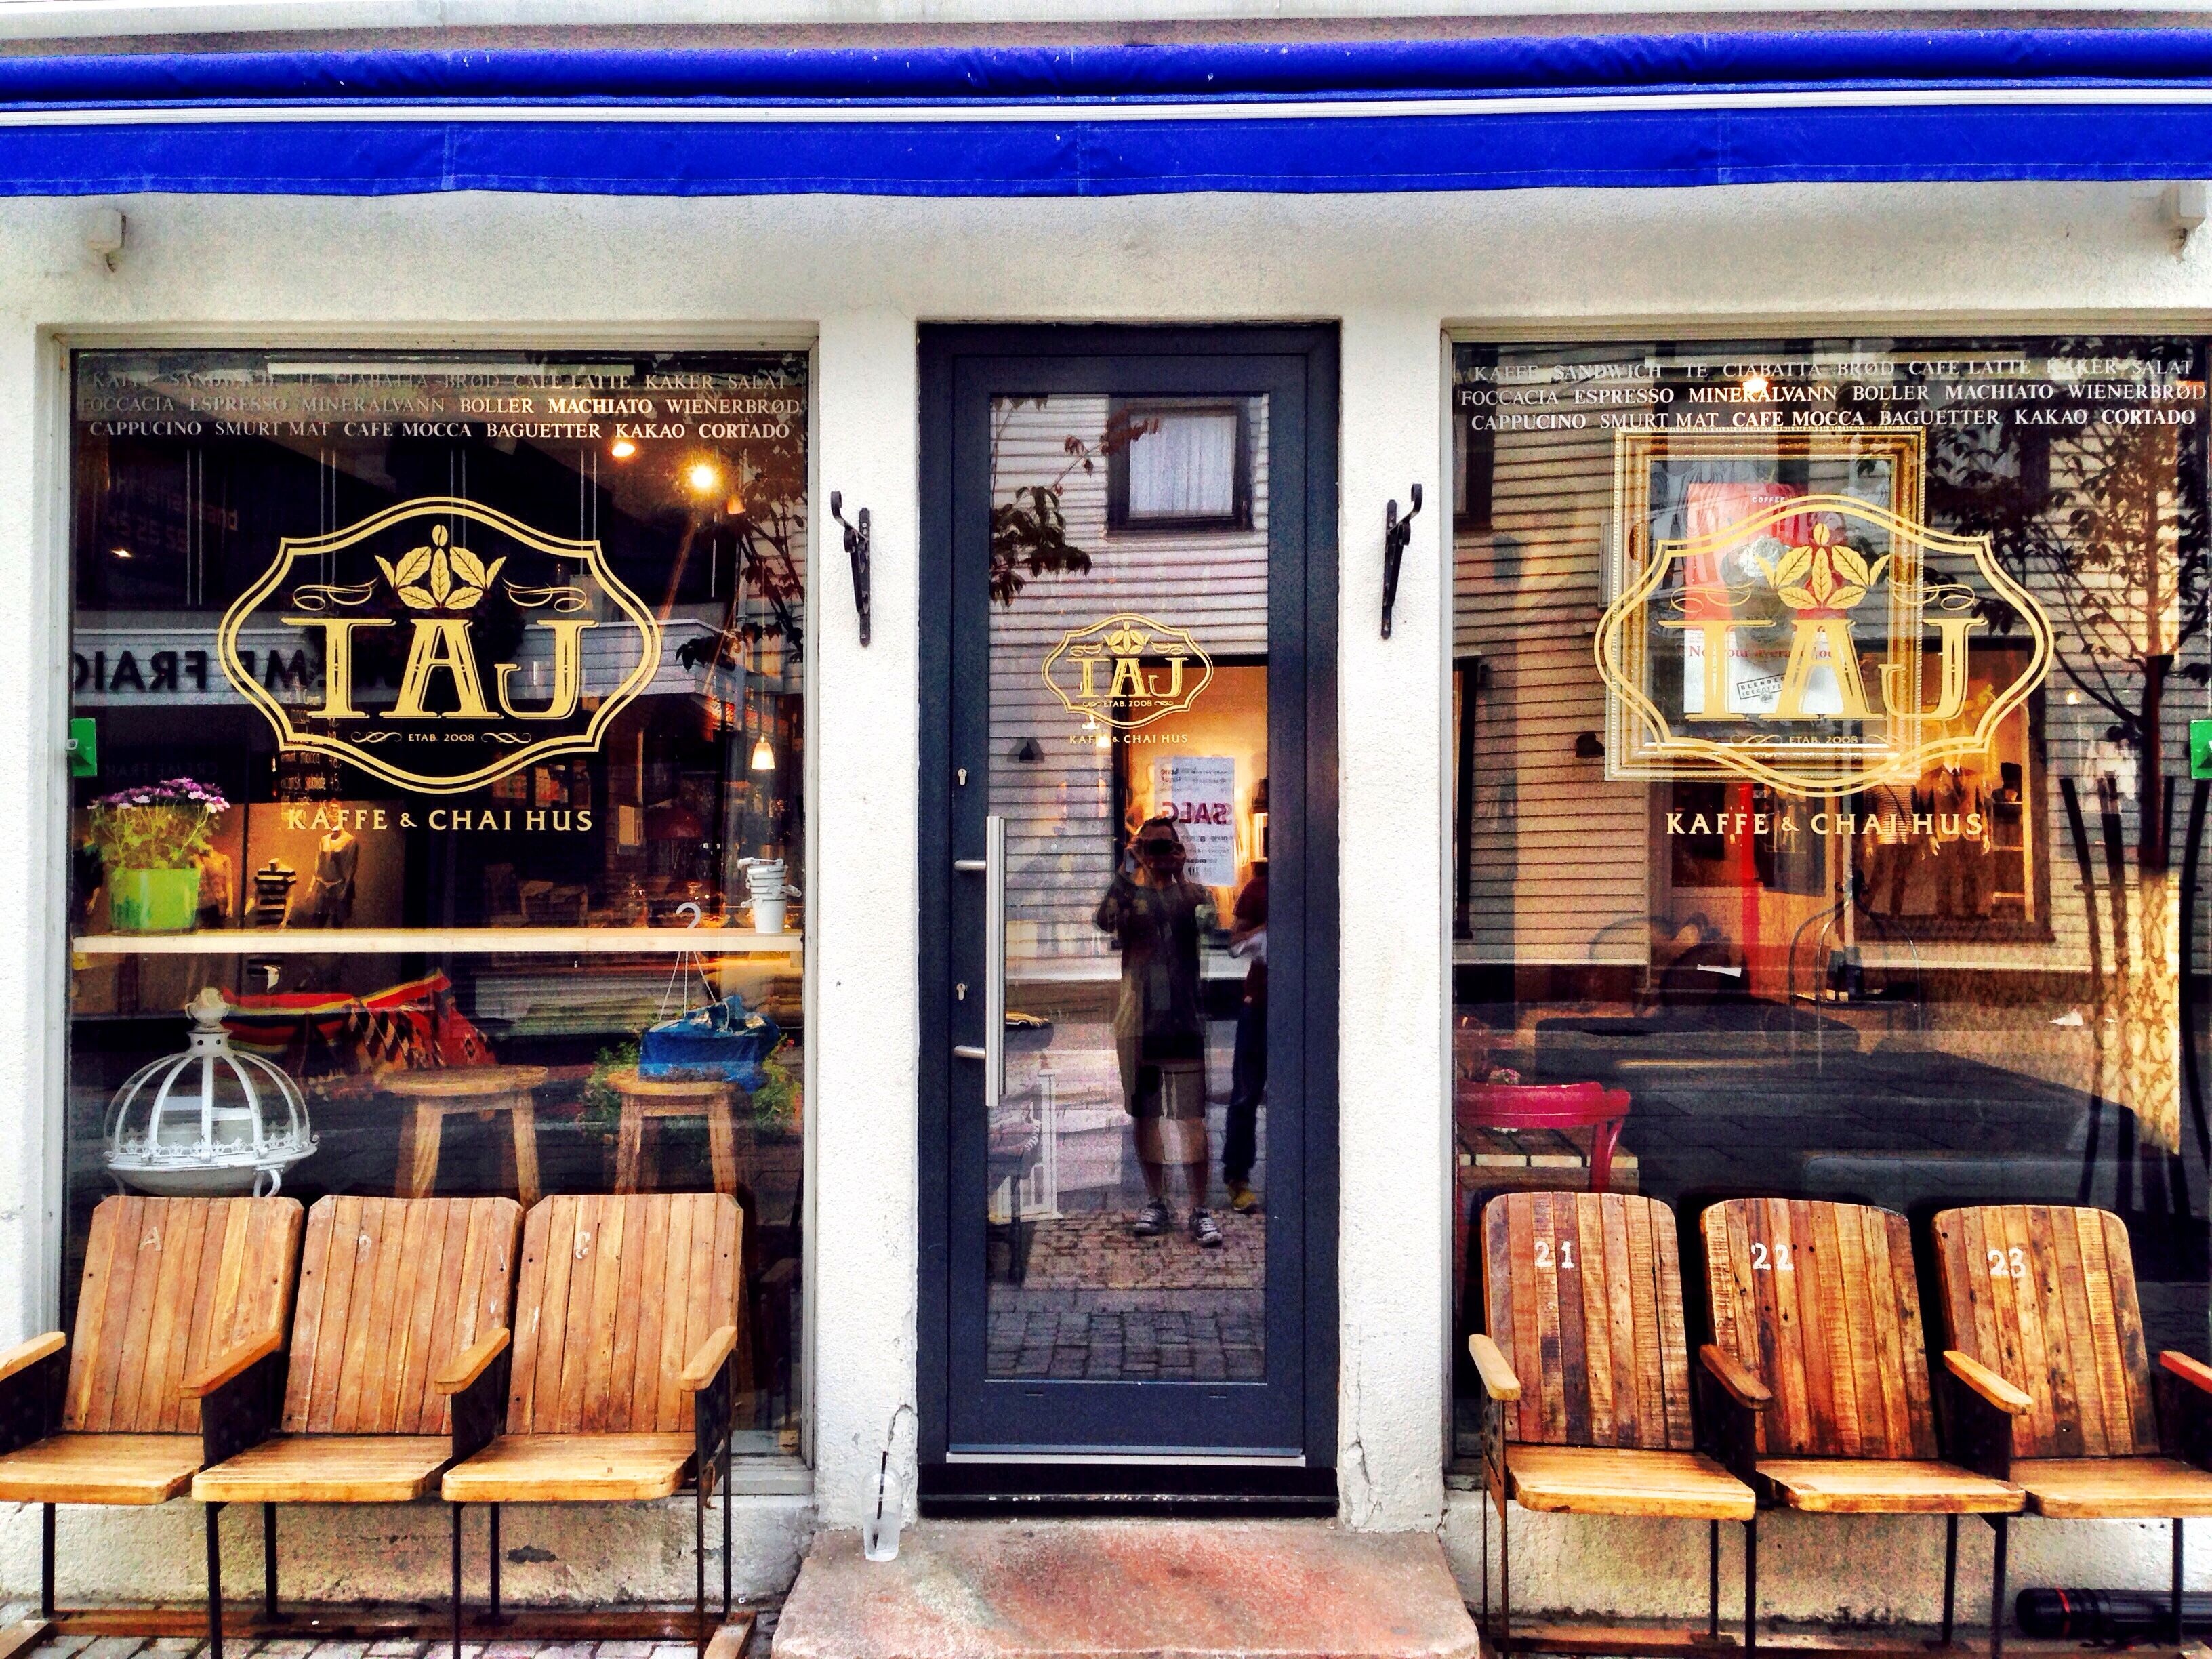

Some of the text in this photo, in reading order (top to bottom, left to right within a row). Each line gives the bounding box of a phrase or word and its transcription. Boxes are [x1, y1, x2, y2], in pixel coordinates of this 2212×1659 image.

[445, 372, 499, 390] BRØD
[513, 372, 563, 390] CAFE
[571, 373, 631, 390] LATTE
[645, 374, 713, 390] KAKER
[727, 374, 788, 390] SALAT
[1474, 359, 2192, 382] KAFFE SANDWICH TE CIABATTA BRØD CAFE LATTE KAKER SALAT
[83, 396, 800, 415] FOCCACIA ESPRESSO MINERALVANN BOLLER MACHIATO WIENERBRØD
[1461, 384, 2207, 406] FOCCACIA ESPRESSO MINERALVANN BOLLER MACHIATO WIENERBRØD
[1471, 408, 2196, 430] CAPPUCINO SMURT MAT CAFE MOCCA BAGUETTER KAKAO CORTADO
[90, 422, 790, 439] CAPPUCINO SMURT MAT CAFE MOCCA BAGUETTER KAKAO CORTADO
[280, 617, 600, 720] TAJ
[1065, 657, 1189, 698] TAJ
[1658, 617, 1988, 721] TAJ
[1740, 676, 1785, 691] BLENDED
[1742, 684, 1783, 697] ICECOFFE
[444, 733, 474, 742] 2008
[1069, 734, 1111, 745] KAF
[1124, 735, 1156, 743] CHAI
[1162, 734, 1188, 743] HUS
[1826, 735, 1858, 744] 2008
[287, 808, 593, 832] KAFFE & CHAI HUS
[1667, 812, 1983, 835] KAFFE & CHAI HUS
[138, 1225, 163, 1252] A
[1534, 1241, 1576, 1269] 21
[1751, 1243, 1795, 1272] 22
[1987, 1248, 2027, 1279] 23
